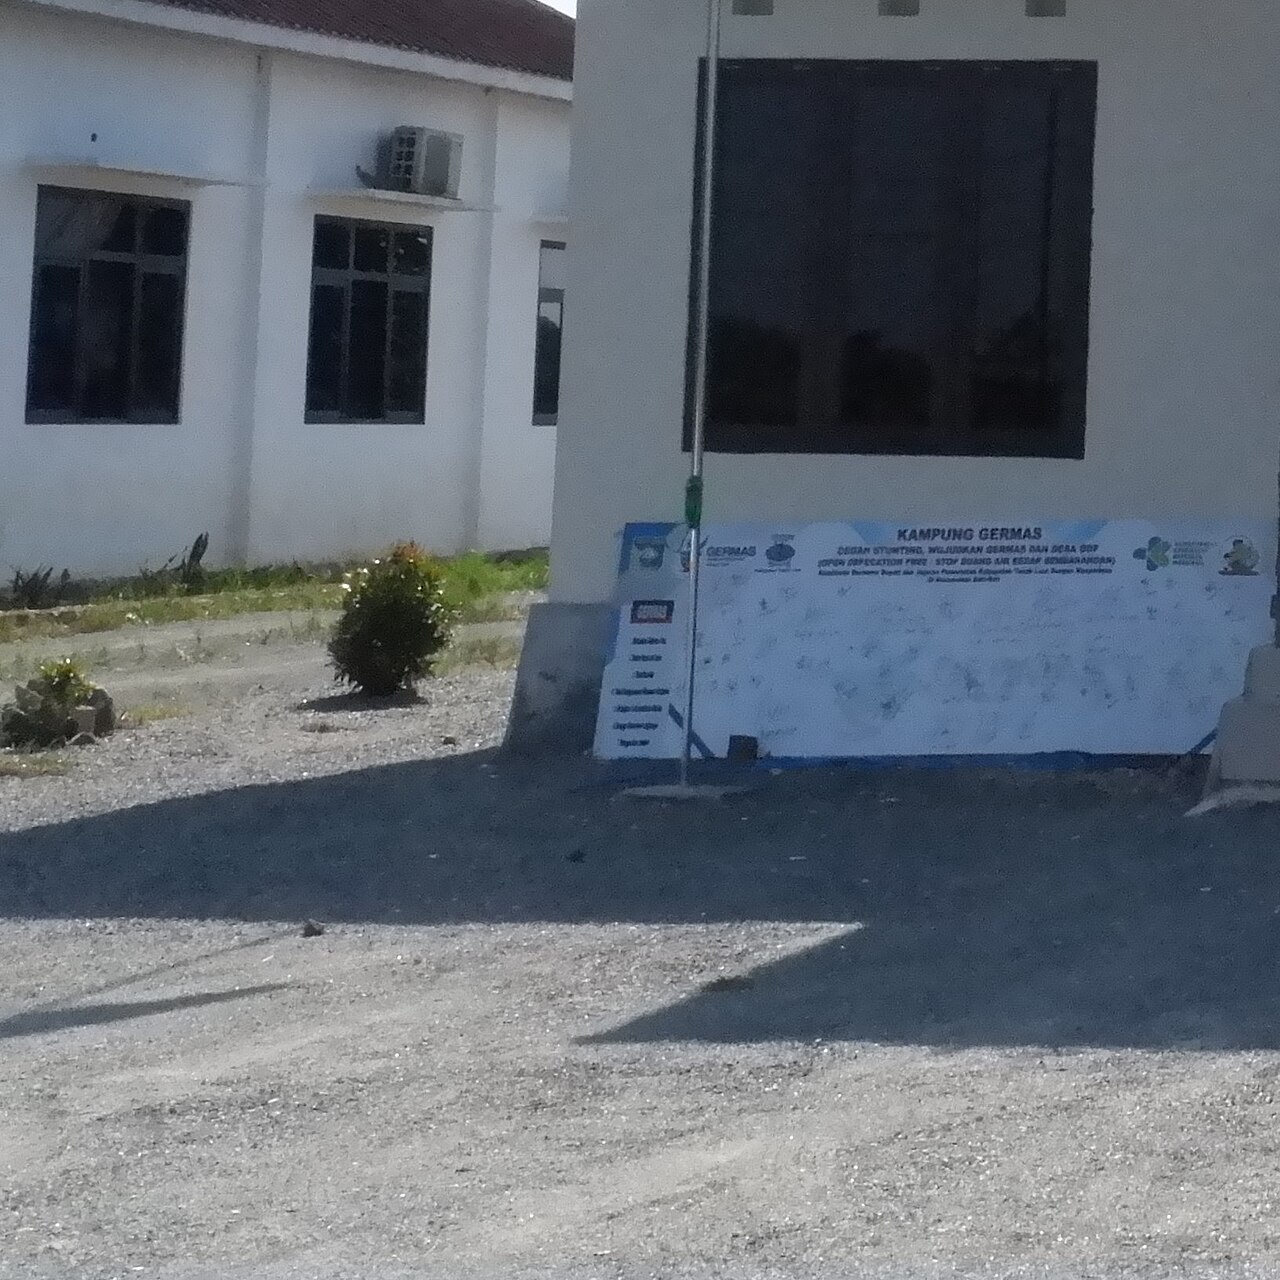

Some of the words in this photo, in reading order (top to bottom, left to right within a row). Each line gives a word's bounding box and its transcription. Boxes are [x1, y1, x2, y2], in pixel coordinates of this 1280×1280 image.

[897, 528, 974, 542] KAMPUNG
[978, 527, 1042, 541] GERMAS
[706, 546, 757, 557] GERMAS
